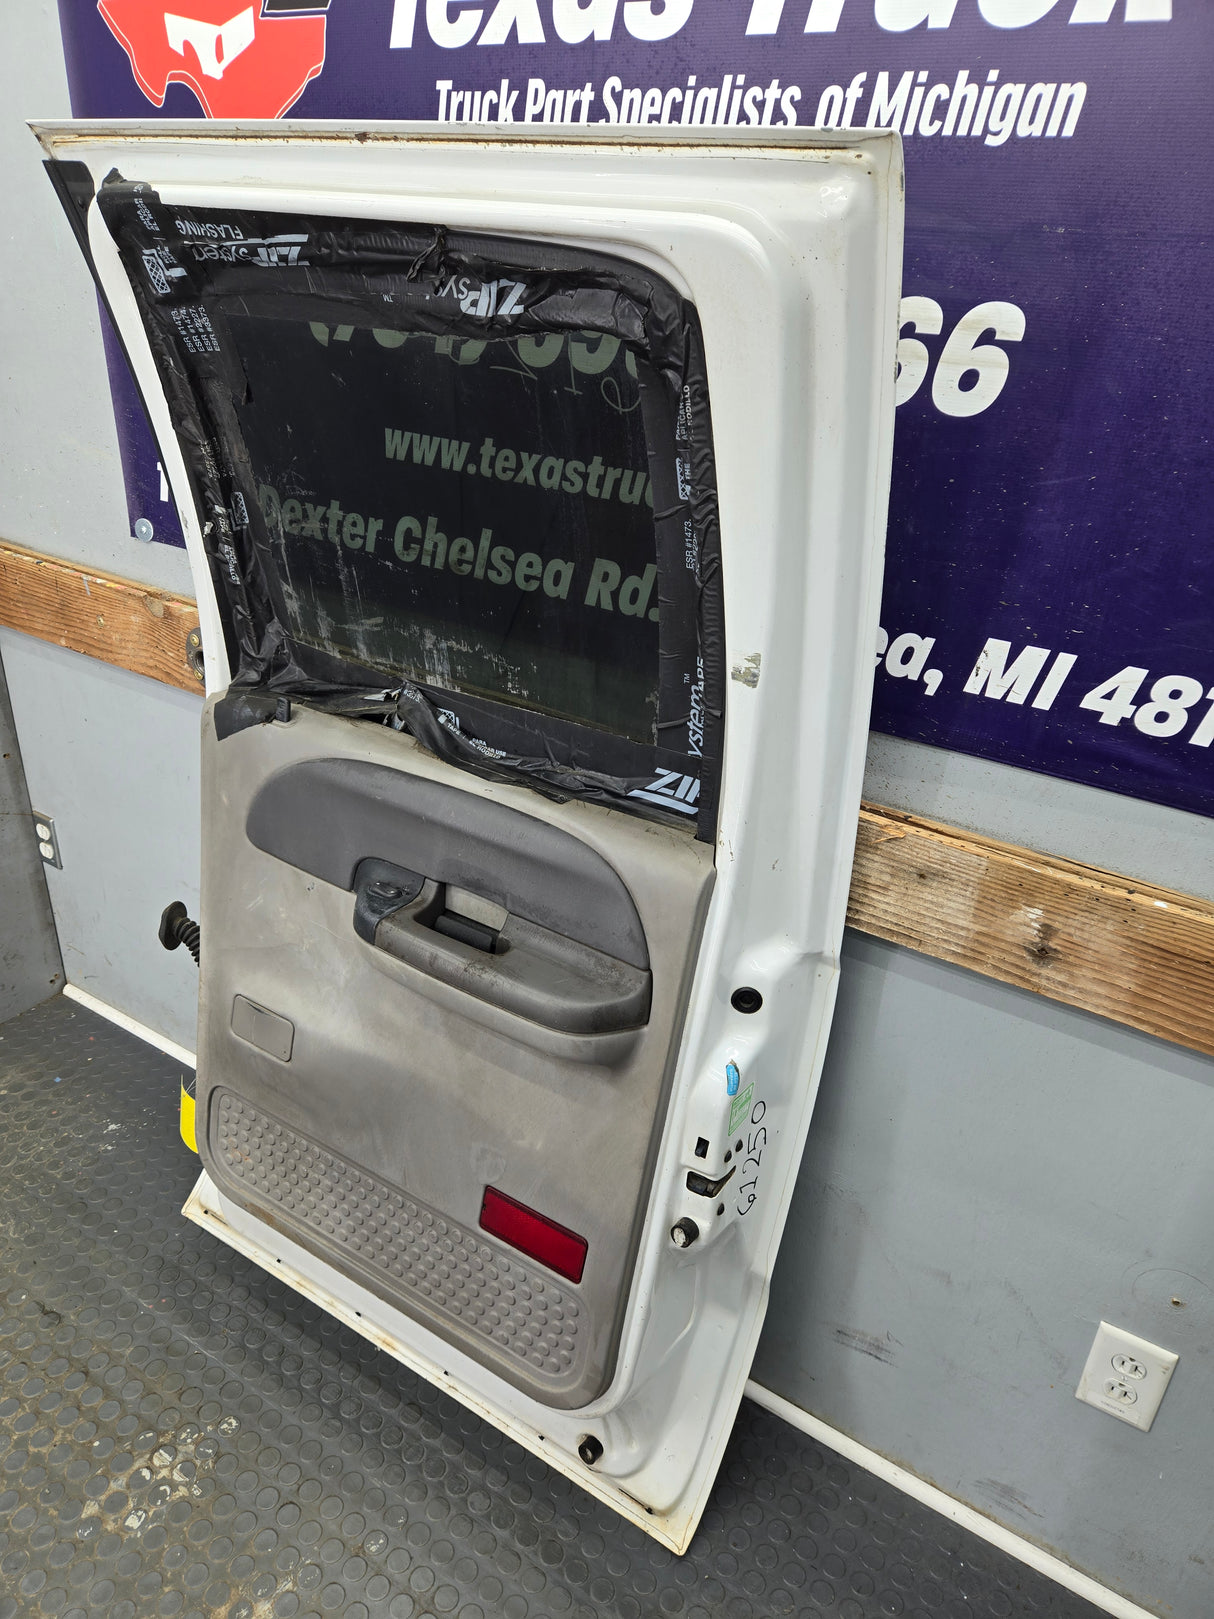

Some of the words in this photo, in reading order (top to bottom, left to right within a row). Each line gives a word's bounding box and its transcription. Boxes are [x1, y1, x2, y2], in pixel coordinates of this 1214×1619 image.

[436, 79, 520, 122] Truck
[525, 78, 595, 123] Part
[599, 75, 801, 127] Specialists
[814, 71, 868, 128] of
[866, 69, 1088, 147] Michigan
[175, 219, 244, 240] FLASHING
[460, 278, 527, 318] ZIP
[183, 337, 197, 353] ESR
[192, 335, 205, 352] ESR
[200, 334, 214, 352] ESR
[209, 333, 221, 352] ESR
[259, 484, 384, 553] Dexter
[393, 515, 575, 600] Chelsea
[584, 557, 660, 622] Rd.
[962, 637, 1078, 711] MI
